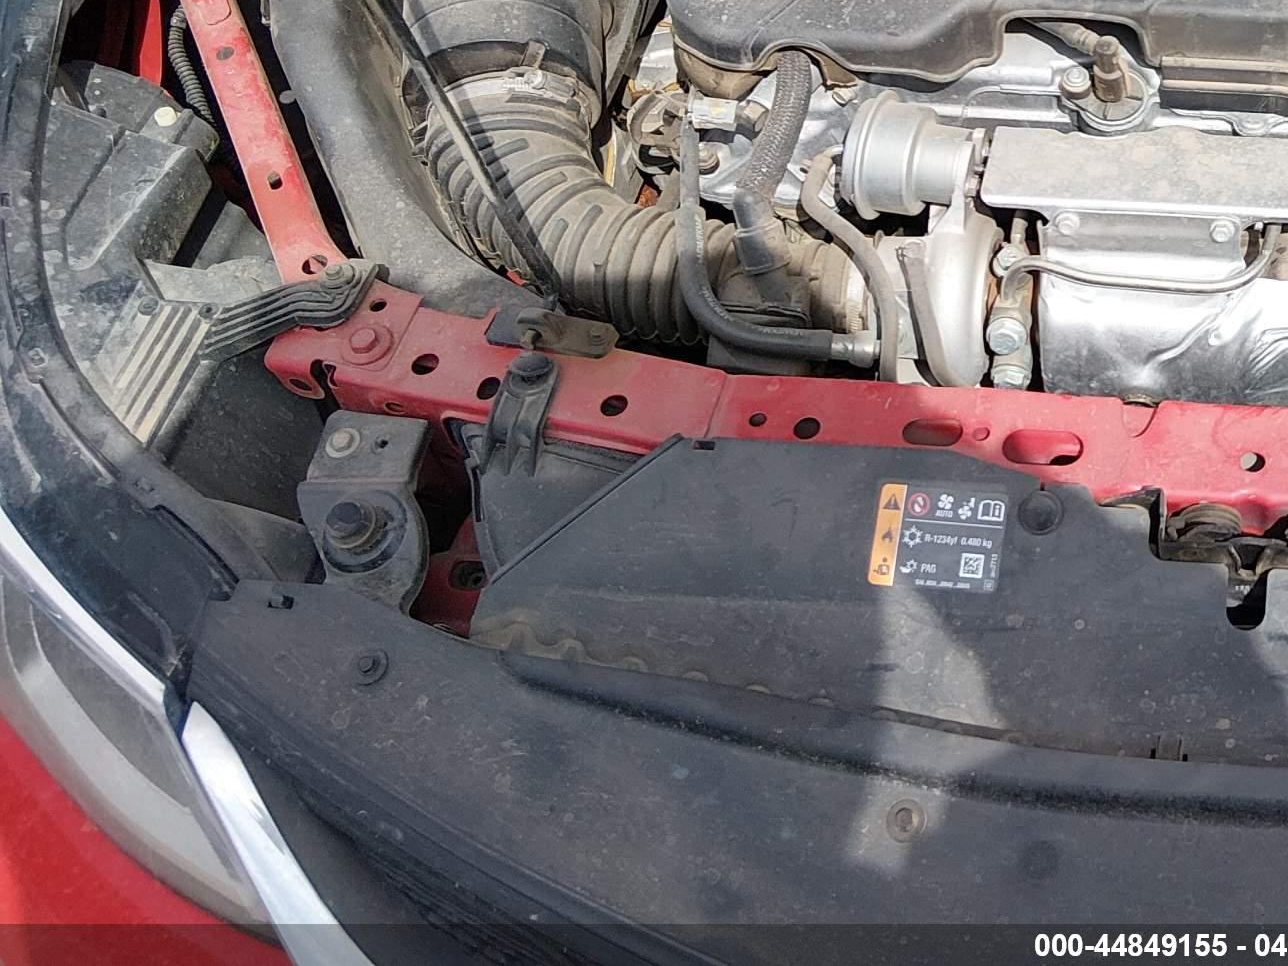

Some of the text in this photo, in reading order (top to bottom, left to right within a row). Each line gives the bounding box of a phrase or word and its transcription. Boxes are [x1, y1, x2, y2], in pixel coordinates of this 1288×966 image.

[935, 510, 954, 518] AUTO
[924, 533, 958, 546] R-1234yf
[982, 538, 993, 549] kg
[920, 563, 937, 574] PAG
